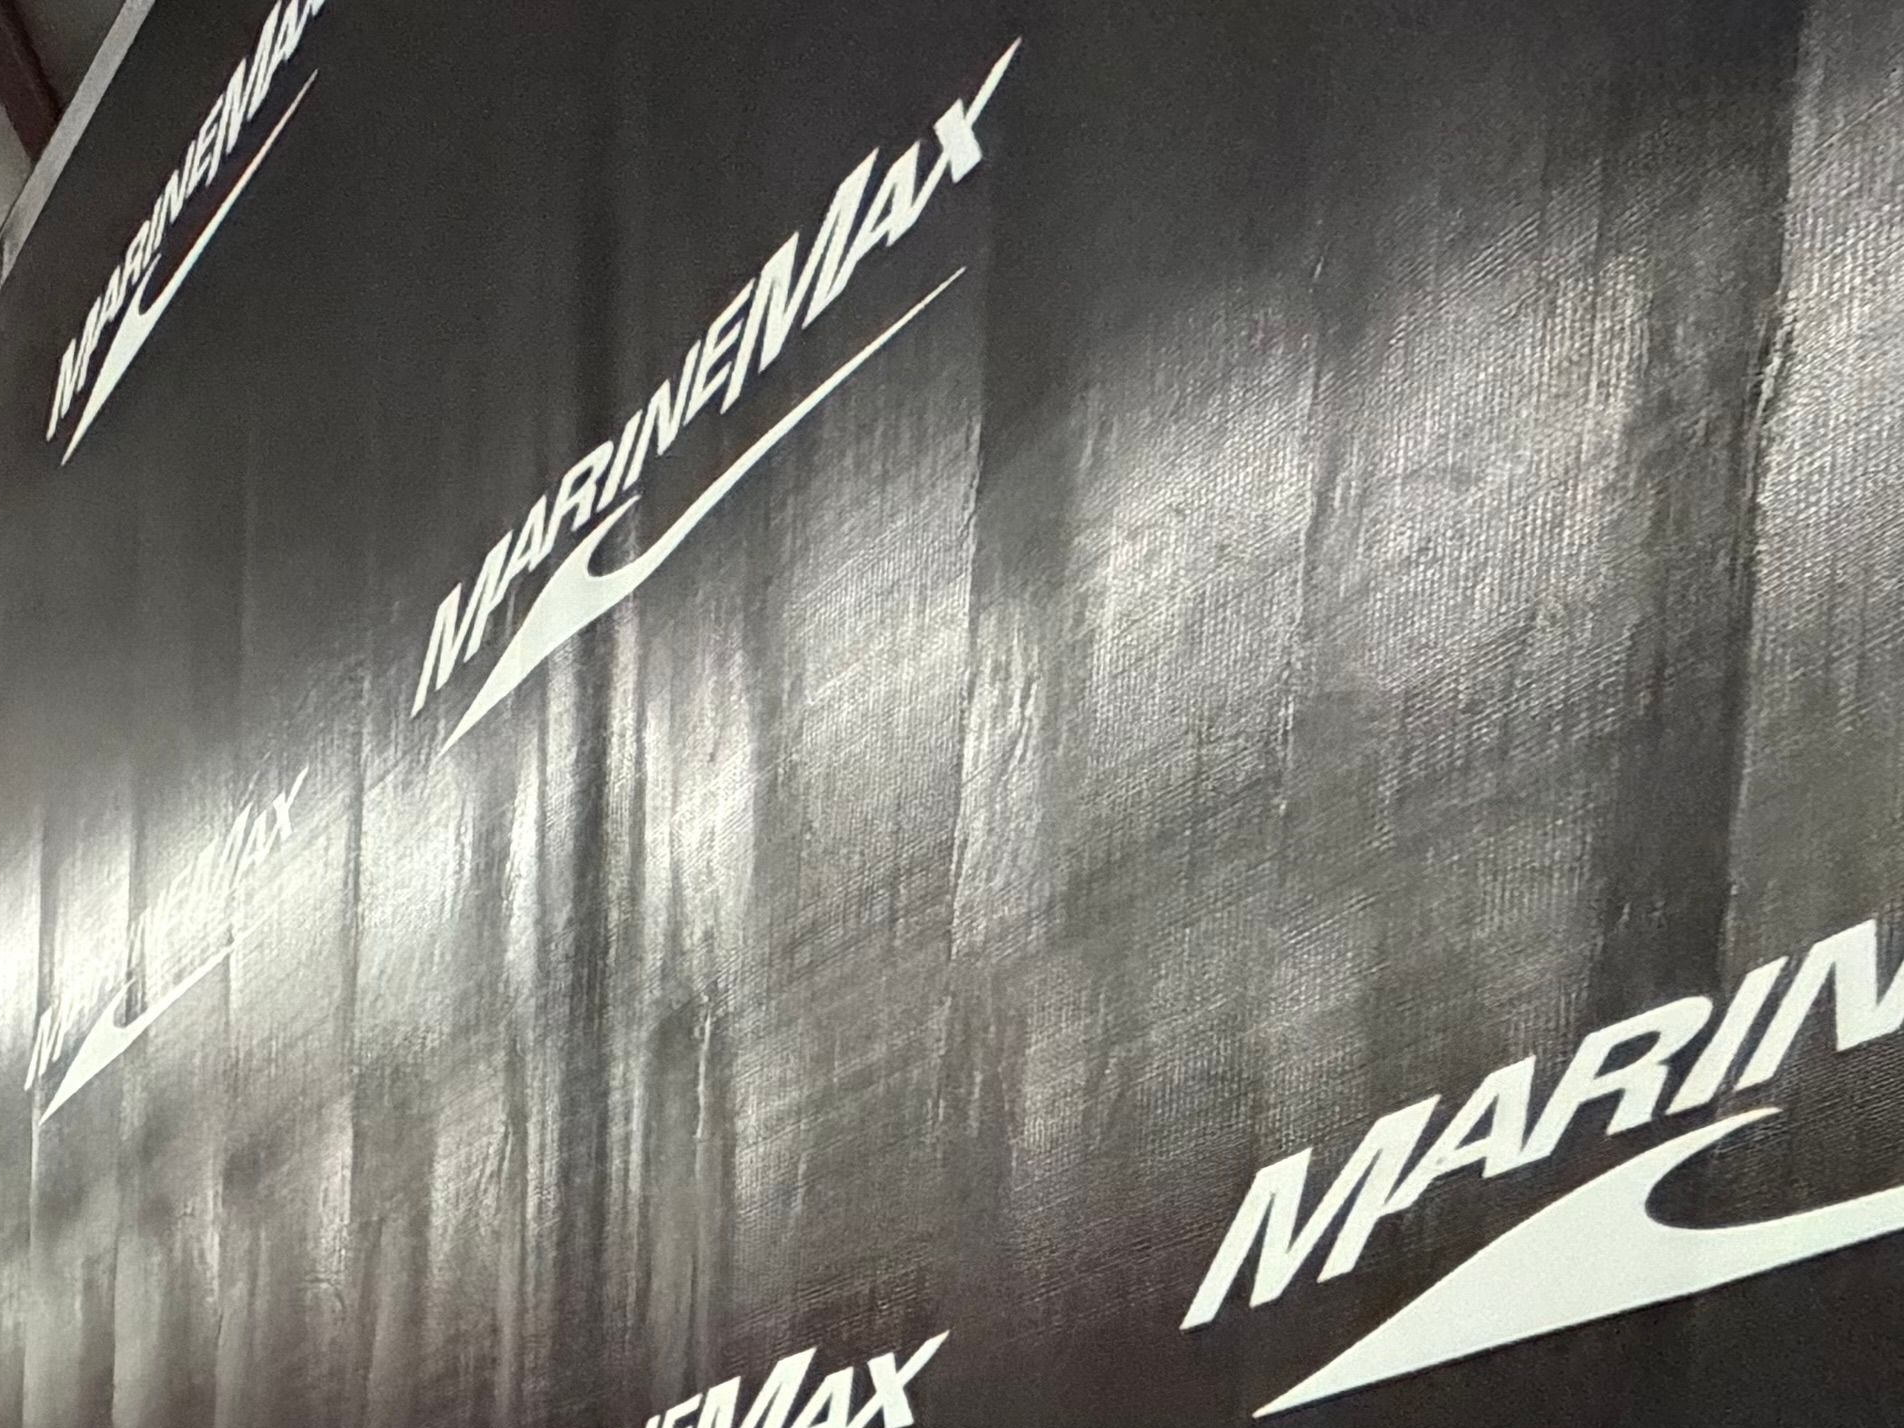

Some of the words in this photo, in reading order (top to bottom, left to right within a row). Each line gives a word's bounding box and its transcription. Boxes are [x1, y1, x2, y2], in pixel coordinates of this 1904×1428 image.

[46, 0, 326, 442] MARINEMA
[410, 36, 1022, 718] MARINEMAX
[1180, 918, 1904, 1331] MARIN
